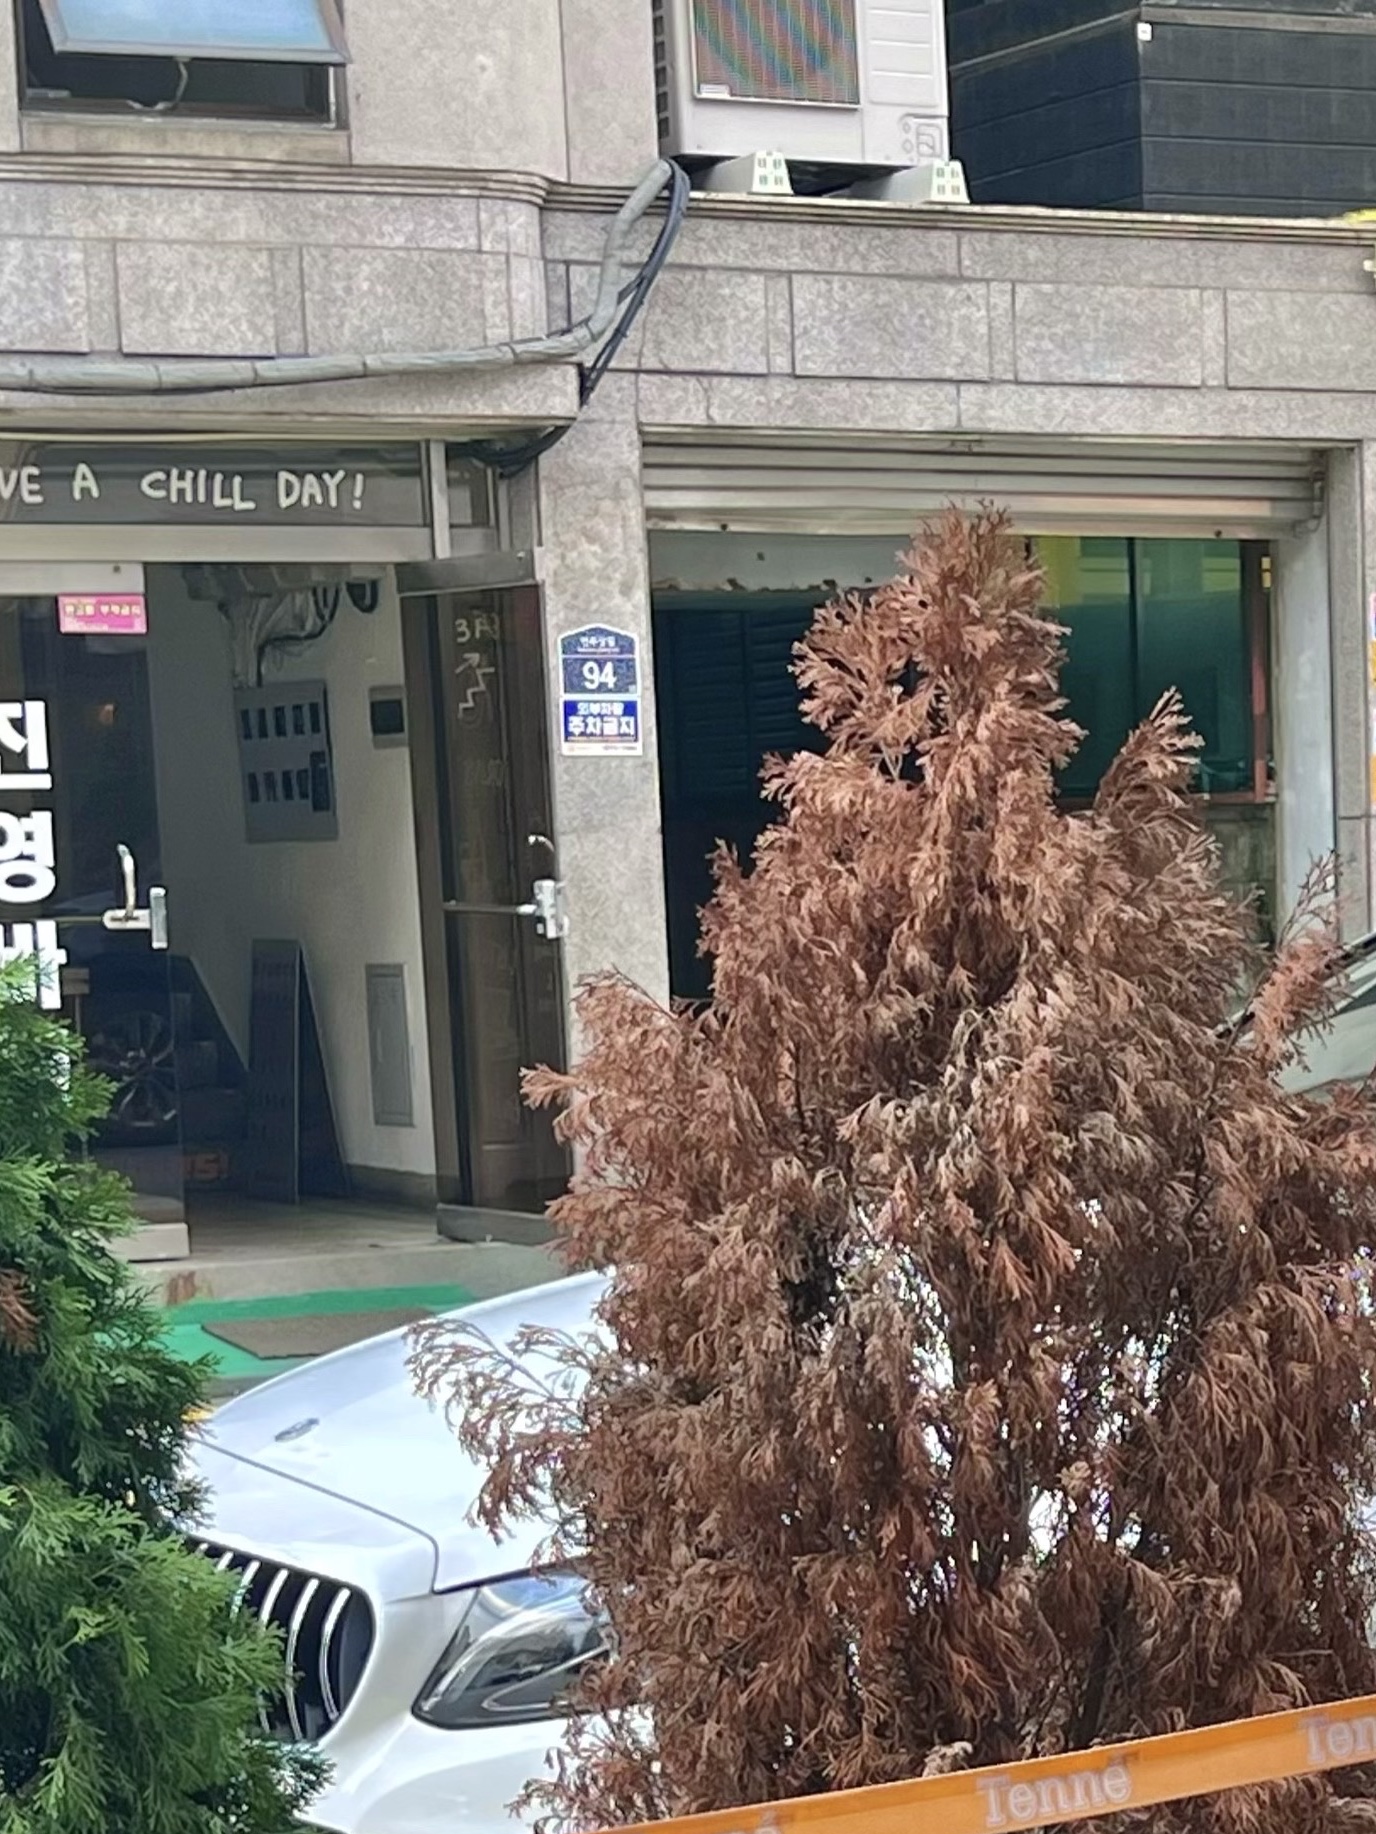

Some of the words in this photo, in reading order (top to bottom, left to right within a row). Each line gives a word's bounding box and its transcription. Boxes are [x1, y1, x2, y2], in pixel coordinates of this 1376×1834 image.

[72, 462, 100, 501] A
[140, 468, 257, 511] CHILL
[277, 469, 365, 510] DAY!
[582, 660, 617, 690] 94
[567, 716, 635, 736] 주차금지
[983, 1753, 1131, 1829] Tenné
